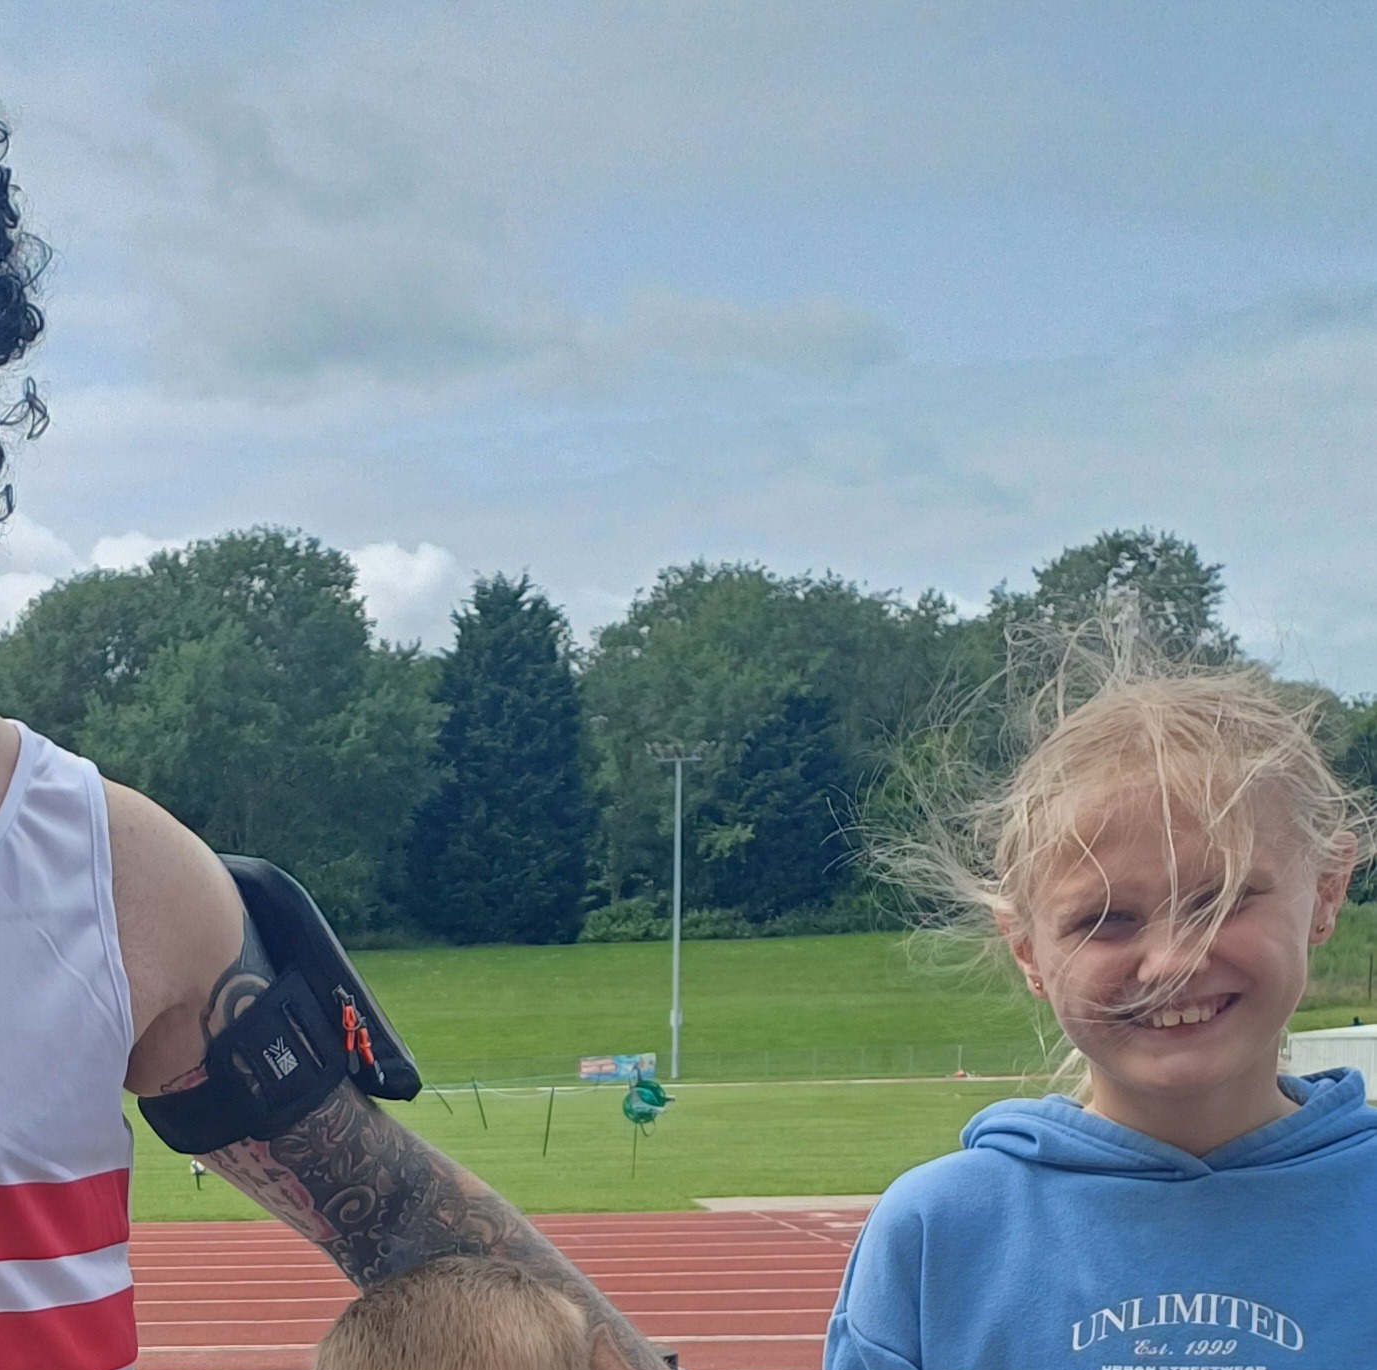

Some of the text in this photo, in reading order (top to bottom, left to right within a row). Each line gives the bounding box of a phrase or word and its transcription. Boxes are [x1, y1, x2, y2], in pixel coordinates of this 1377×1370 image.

[1071, 1292, 1304, 1351] UNLIMITED
[1133, 1338, 1238, 1356] Est. 1999
